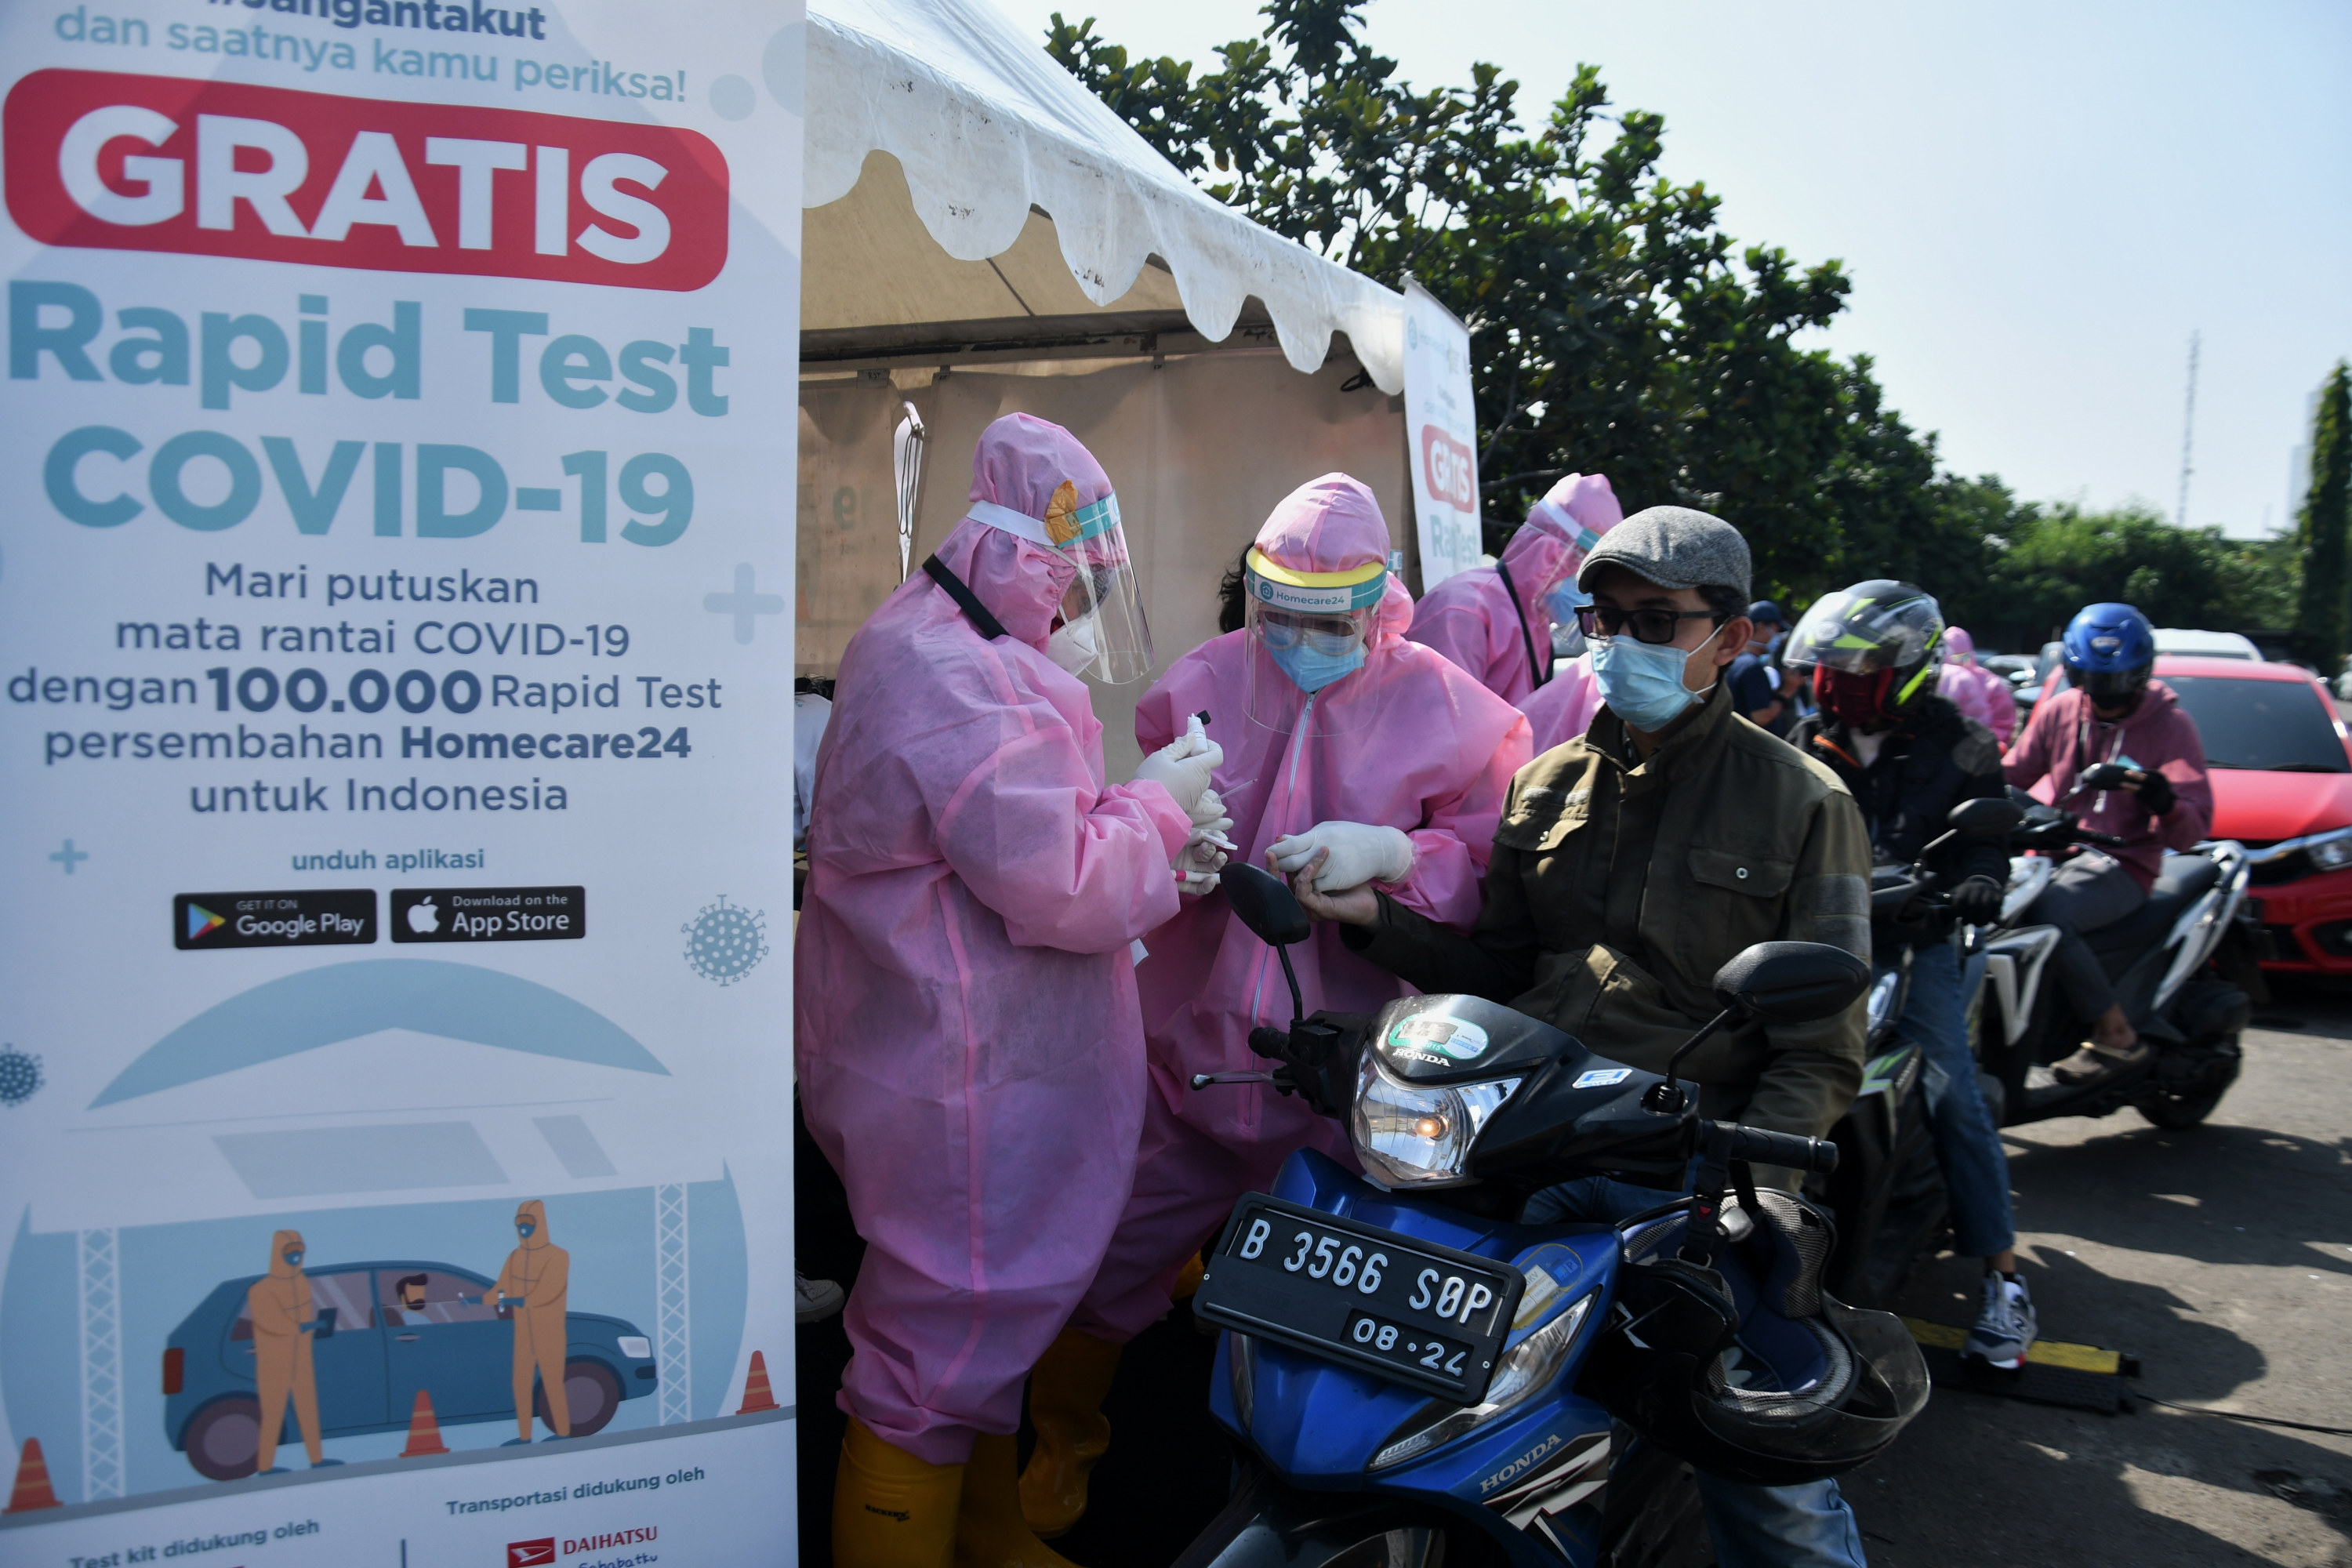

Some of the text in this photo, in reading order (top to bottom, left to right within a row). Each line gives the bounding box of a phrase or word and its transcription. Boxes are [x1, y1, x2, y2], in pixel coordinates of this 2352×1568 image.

[209, 0, 546, 40] angantakut
[54, 5, 687, 102] dan saatnya kamu periksa!
[59, 105, 671, 264] GRATIS
[8, 279, 730, 417] Rapid Test
[43, 424, 695, 547] COVID-19
[1430, 440, 1471, 503] GRTIS
[206, 562, 539, 606] Mari putuskan
[1276, 590, 1345, 605] Homecare24
[117, 618, 630, 656] mata rantai COVID-19
[9, 667, 723, 713] dengan 100.000 Rapid Test
[45, 724, 691, 766] persembahan Homecare24
[191, 777, 568, 812] untuk Indonesia
[292, 848, 484, 873] unduh aplikasi
[237, 899, 298, 910] GET IT ON
[452, 894, 568, 906] Download on the
[237, 913, 364, 938] Google Play
[452, 910, 570, 937] App Store
[1392, 1047, 1451, 1067] HONDA
[1240, 1218, 1271, 1260] B
[1283, 1232, 1388, 1294] 3566
[1479, 1434, 1562, 1494] HONDA
[446, 1467, 705, 1515] Transportasi didukung oleh
[70, 1519, 319, 1568] Test kit didukung oleh
[564, 1526, 658, 1555] DAIHATSU
